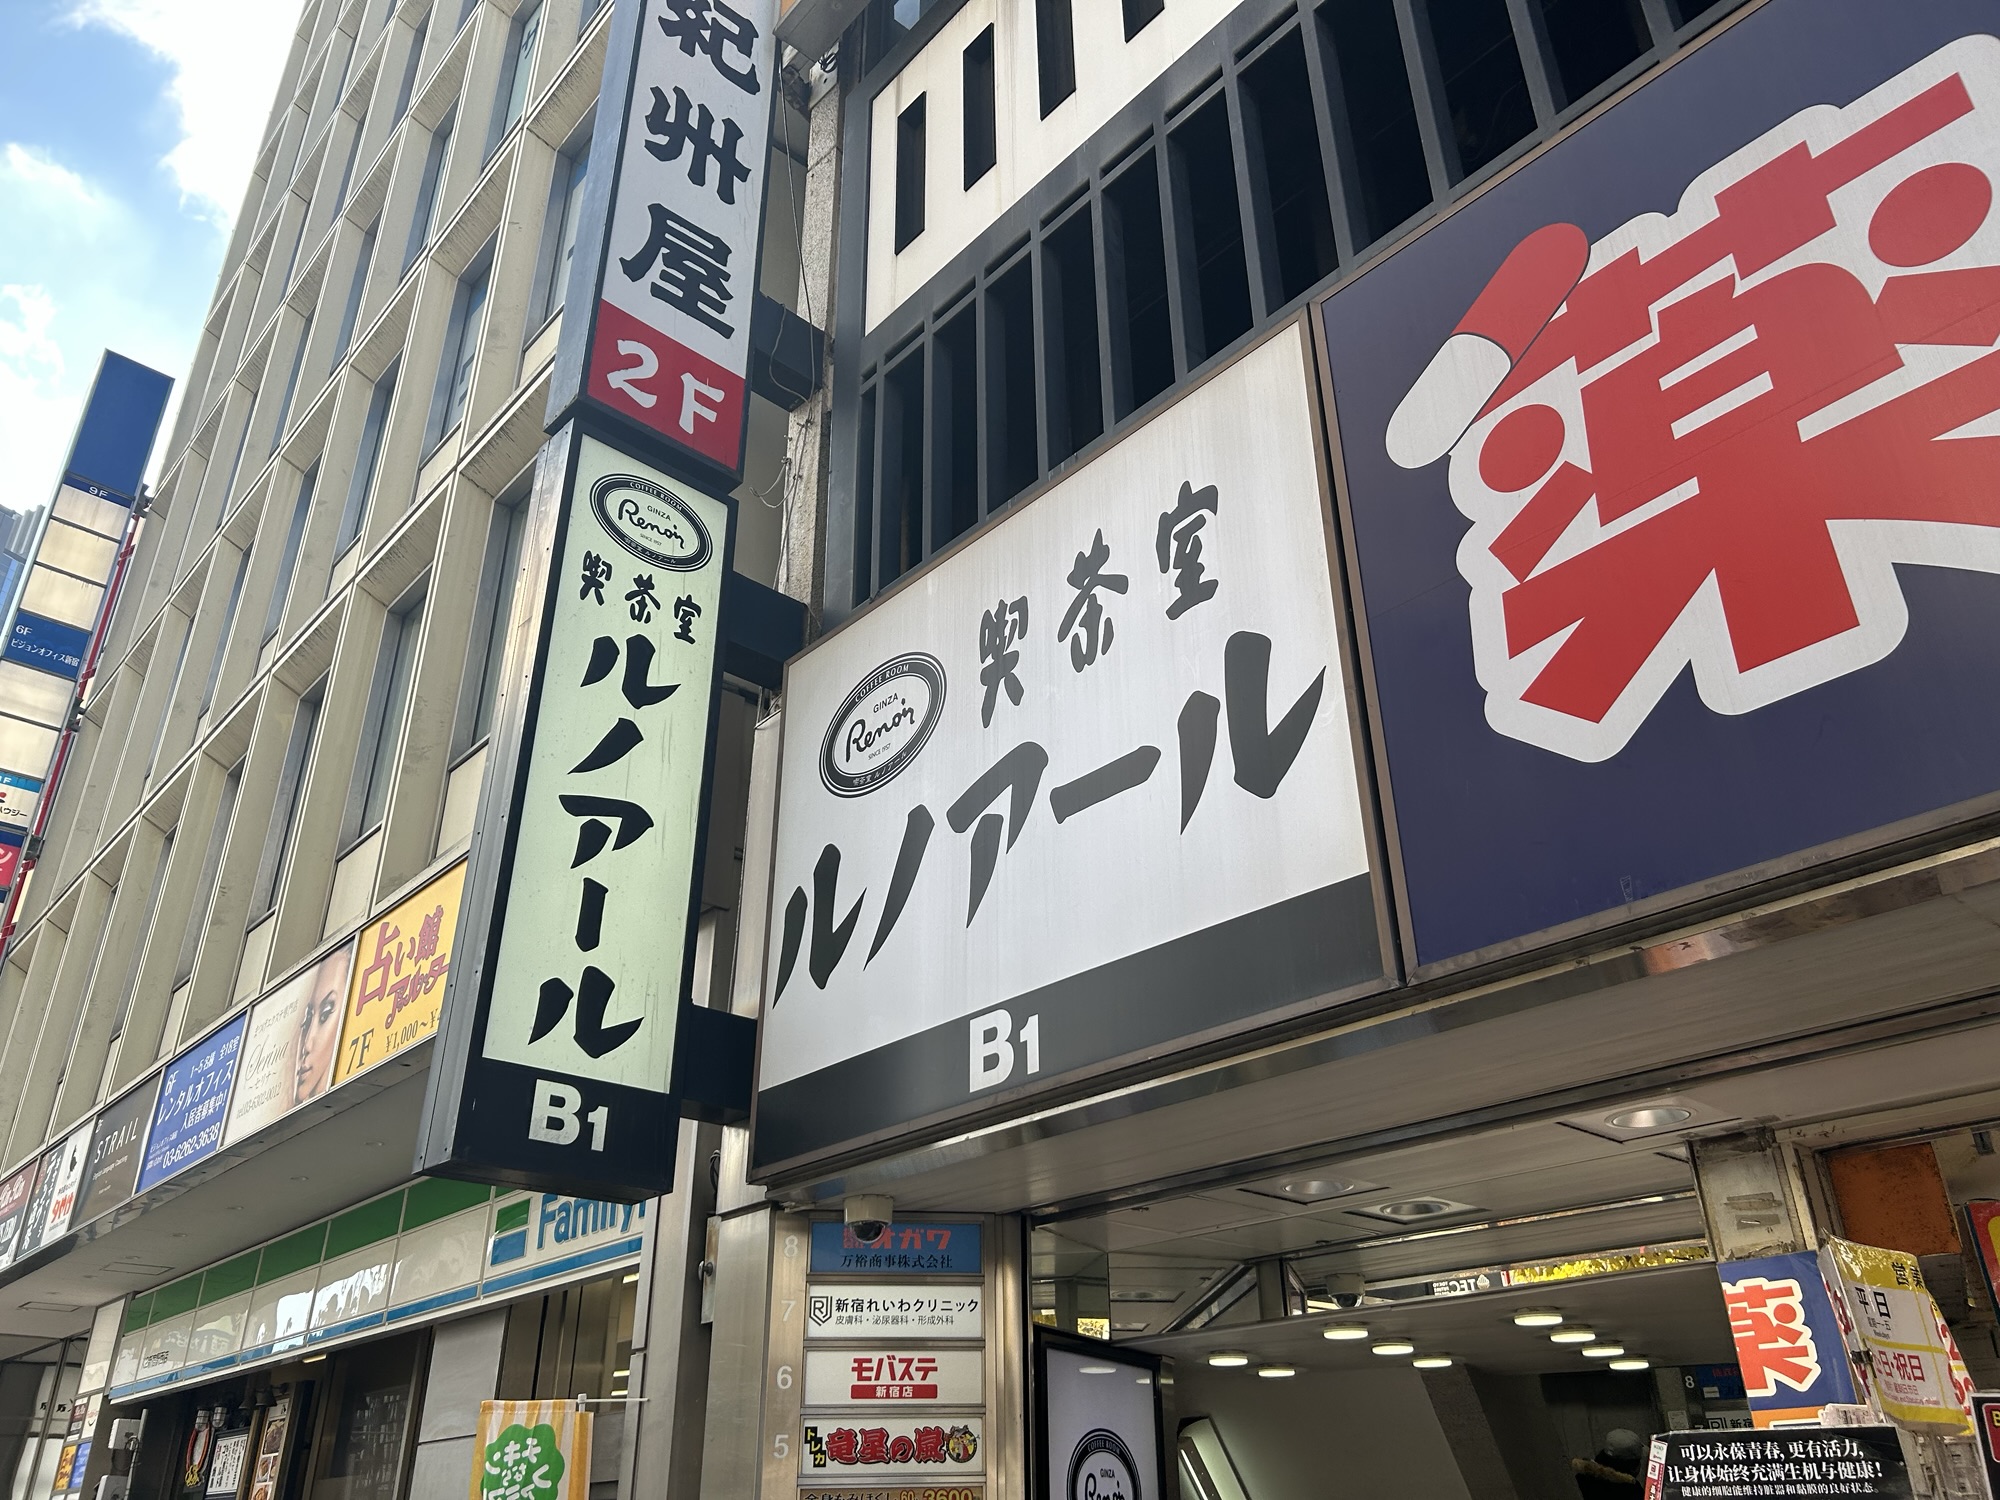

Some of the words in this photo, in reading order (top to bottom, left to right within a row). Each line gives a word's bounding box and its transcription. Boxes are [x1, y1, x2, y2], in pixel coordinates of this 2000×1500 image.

[606, 339, 725, 435] 2F
[88, 486, 109, 498] 9F
[630, 482, 658, 496] COFFEE
[660, 493, 683, 512] ROOM
[646, 505, 672, 522] GINZA
[580, 550, 702, 645] 喫茶室
[979, 480, 1219, 729] 喫茶室
[15, 624, 33, 636] 6F
[11, 638, 80, 667] ビジョンオフィス新宿
[855, 675, 883, 703] COFFEE
[885, 664, 909, 680] ROOM
[872, 692, 899, 714] GINZA
[868, 749, 881, 761] SINCE
[772, 630, 1327, 1011] ルノアール
[528, 634, 682, 1059] ルノアール
[356, 904, 444, 1017] 占い館
[346, 1027, 375, 1076] 7F
[969, 1008, 1041, 1093] B1
[156, 1058, 234, 1127] レンタルオフィス
[164, 1070, 180, 1097] 6F
[528, 1078, 609, 1153] B1
[93, 1117, 139, 1164] STRAIL
[162, 1121, 221, 1169] 03-6262-3638
[537, 1193, 647, 1250] Family
[784, 1235, 798, 1258] 8
[841, 1254, 953, 1269] 万裕商事株式会社
[781, 1300, 797, 1322] 7
[835, 1298, 979, 1313] 新宿れいわクリニック
[1855, 1286, 1891, 1319] 平日
[835, 1315, 954, 1326] 皮膚科・泌尿器科・形成外科
[776, 1365, 793, 1390] 6
[851, 1355, 938, 1382] モバステ
[1684, 1375, 1695, 1389] 8
[875, 1386, 913, 1398] 新宿店
[774, 1434, 790, 1459] 5
[805, 1428, 826, 1467] トレカ
[826, 1426, 946, 1465] 竜星の嵐
[1100, 1468, 1115, 1478] GINZA
